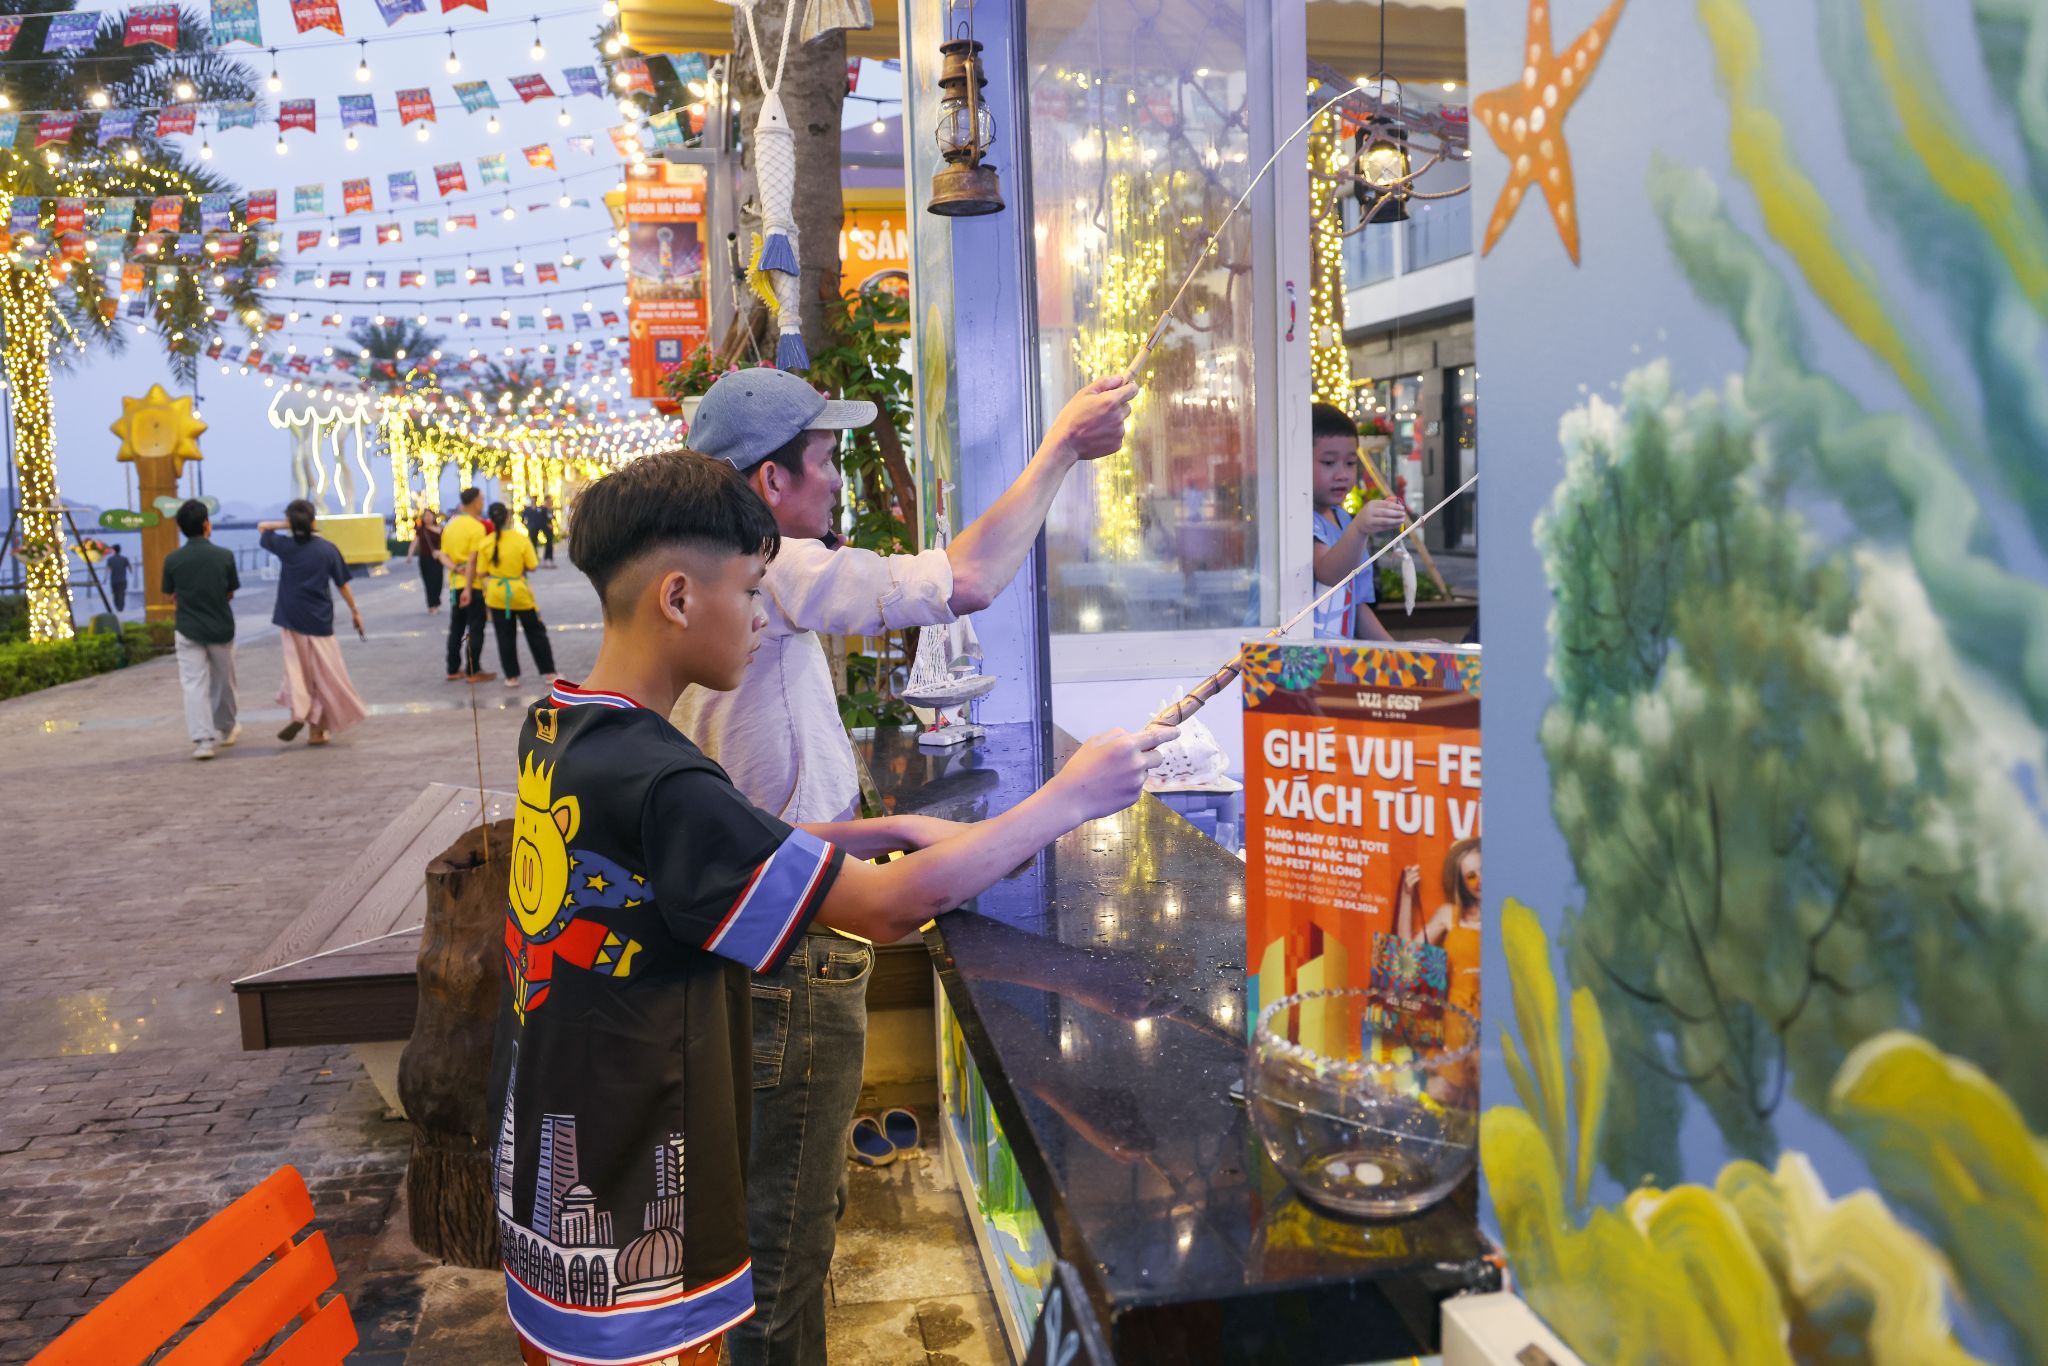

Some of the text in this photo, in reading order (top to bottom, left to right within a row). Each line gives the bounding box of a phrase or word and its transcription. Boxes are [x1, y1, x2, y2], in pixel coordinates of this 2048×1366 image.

[1263, 726, 1337, 773] GHÉ
[1264, 774, 1362, 827] XÁCH
[1373, 786, 1435, 836] TÚI
[1295, 831, 1325, 845] NGAY
[1340, 836, 1358, 849] TÚI
[1360, 840, 1389, 854] TOTE
[1265, 854, 1311, 870] VUI-FEST
[1330, 865, 1362, 879] LONG
